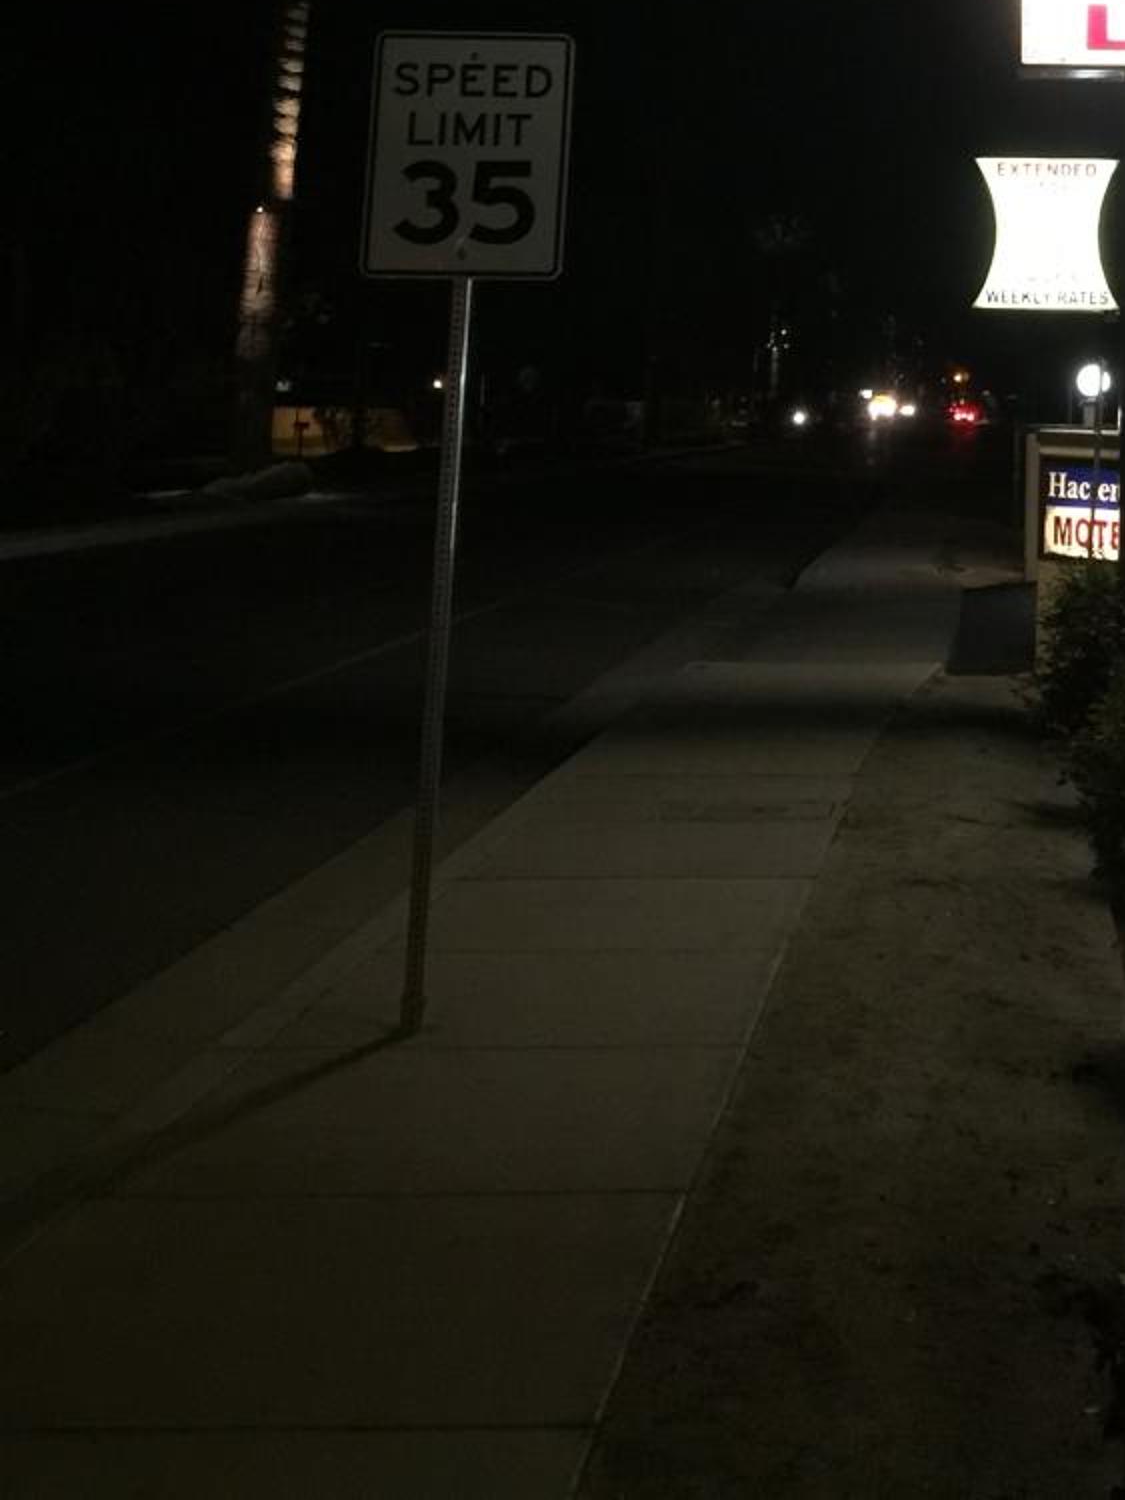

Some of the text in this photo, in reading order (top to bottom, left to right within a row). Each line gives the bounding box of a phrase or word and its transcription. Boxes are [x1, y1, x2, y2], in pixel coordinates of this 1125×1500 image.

[394, 62, 554, 98] SPEED
[407, 111, 533, 147] LIMIT
[996, 162, 1098, 177] EXTENDED
[392, 159, 536, 245] 35
